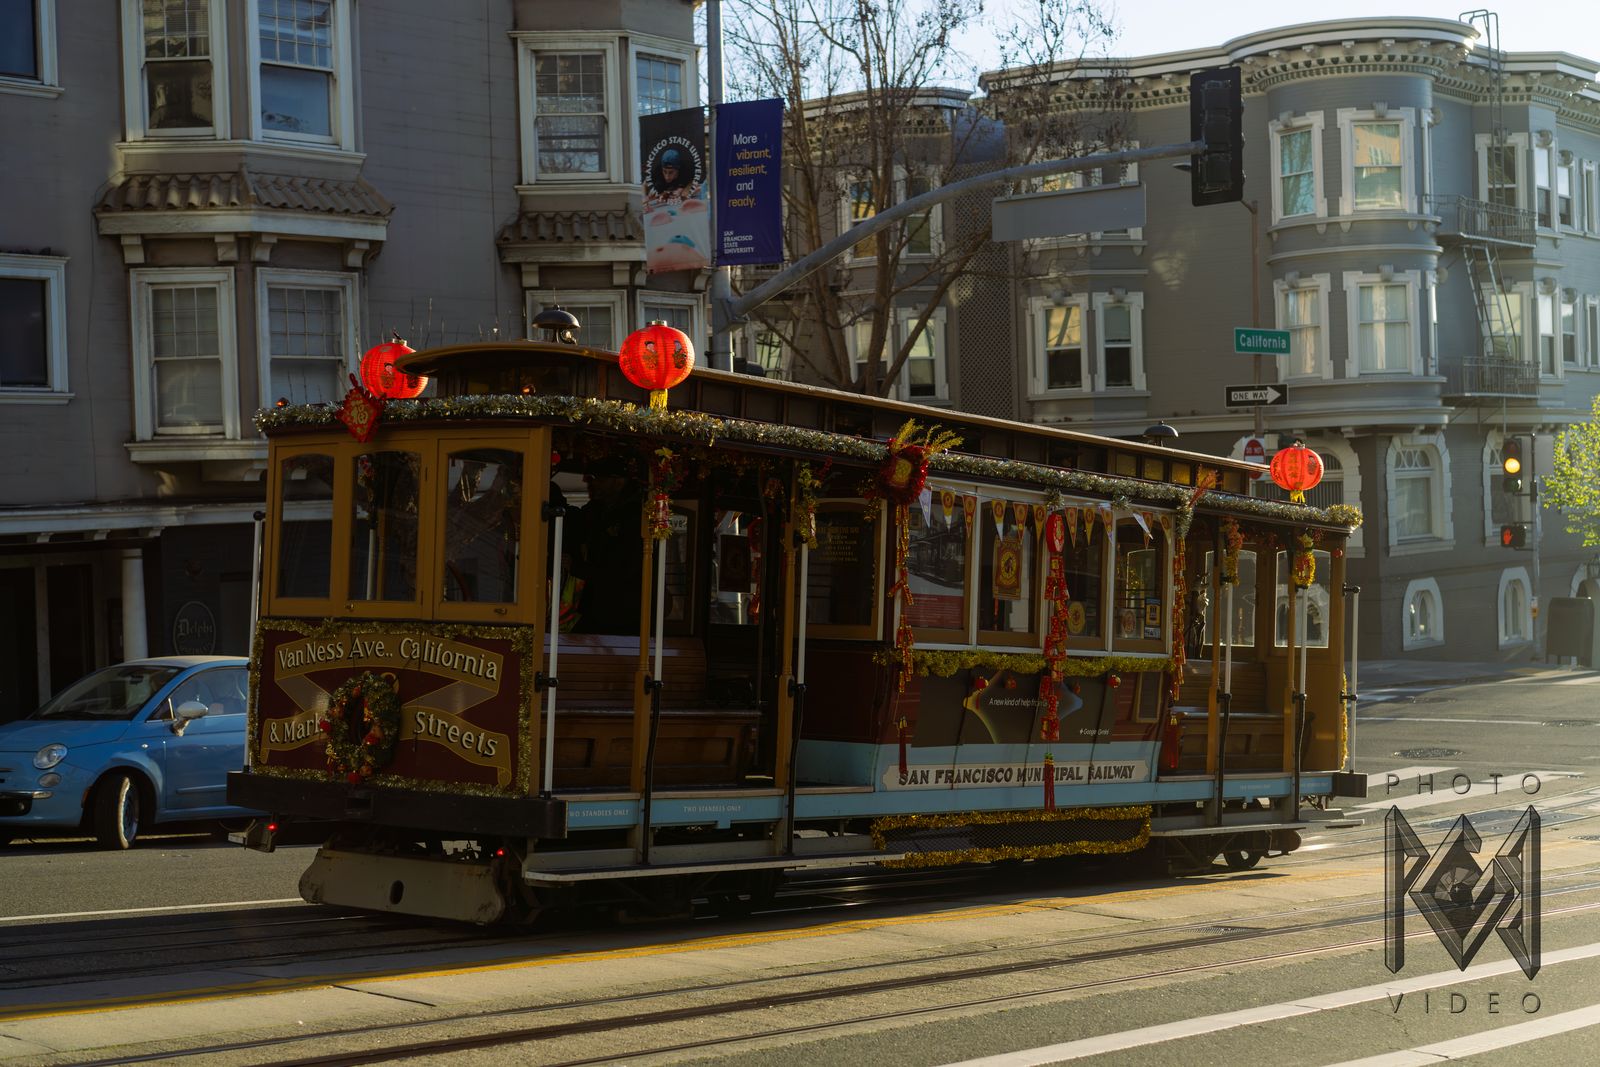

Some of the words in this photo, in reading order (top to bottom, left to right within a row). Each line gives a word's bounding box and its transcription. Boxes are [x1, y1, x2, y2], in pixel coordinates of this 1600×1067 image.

[668, 136, 691, 149] STATE
[733, 133, 758, 146] More
[736, 148, 772, 161] vibrant,
[728, 163, 768, 177] resilient,
[736, 179, 754, 192] and
[728, 195, 757, 209] ready.
[1239, 333, 1287, 349] California
[1233, 391, 1249, 401] ONE
[1252, 391, 1269, 400] WAY
[278, 647, 304, 670] Van
[305, 641, 344, 664] Ness
[400, 637, 497, 682] California
[269, 721, 280, 744] &
[283, 712, 324, 743] Mark
[413, 711, 498, 757] Streets
[898, 769, 930, 786] SAN
[935, 767, 1013, 785] FRANCISCO
[1016, 766, 1084, 783] MUNIIPAL
[1088, 764, 1135, 781] RAILWAY
[582, 809, 612, 817] STANDEES
[613, 809, 629, 817] ONLY
[683, 805, 697, 813] TWO
[698, 805, 726, 813] STANDEES
